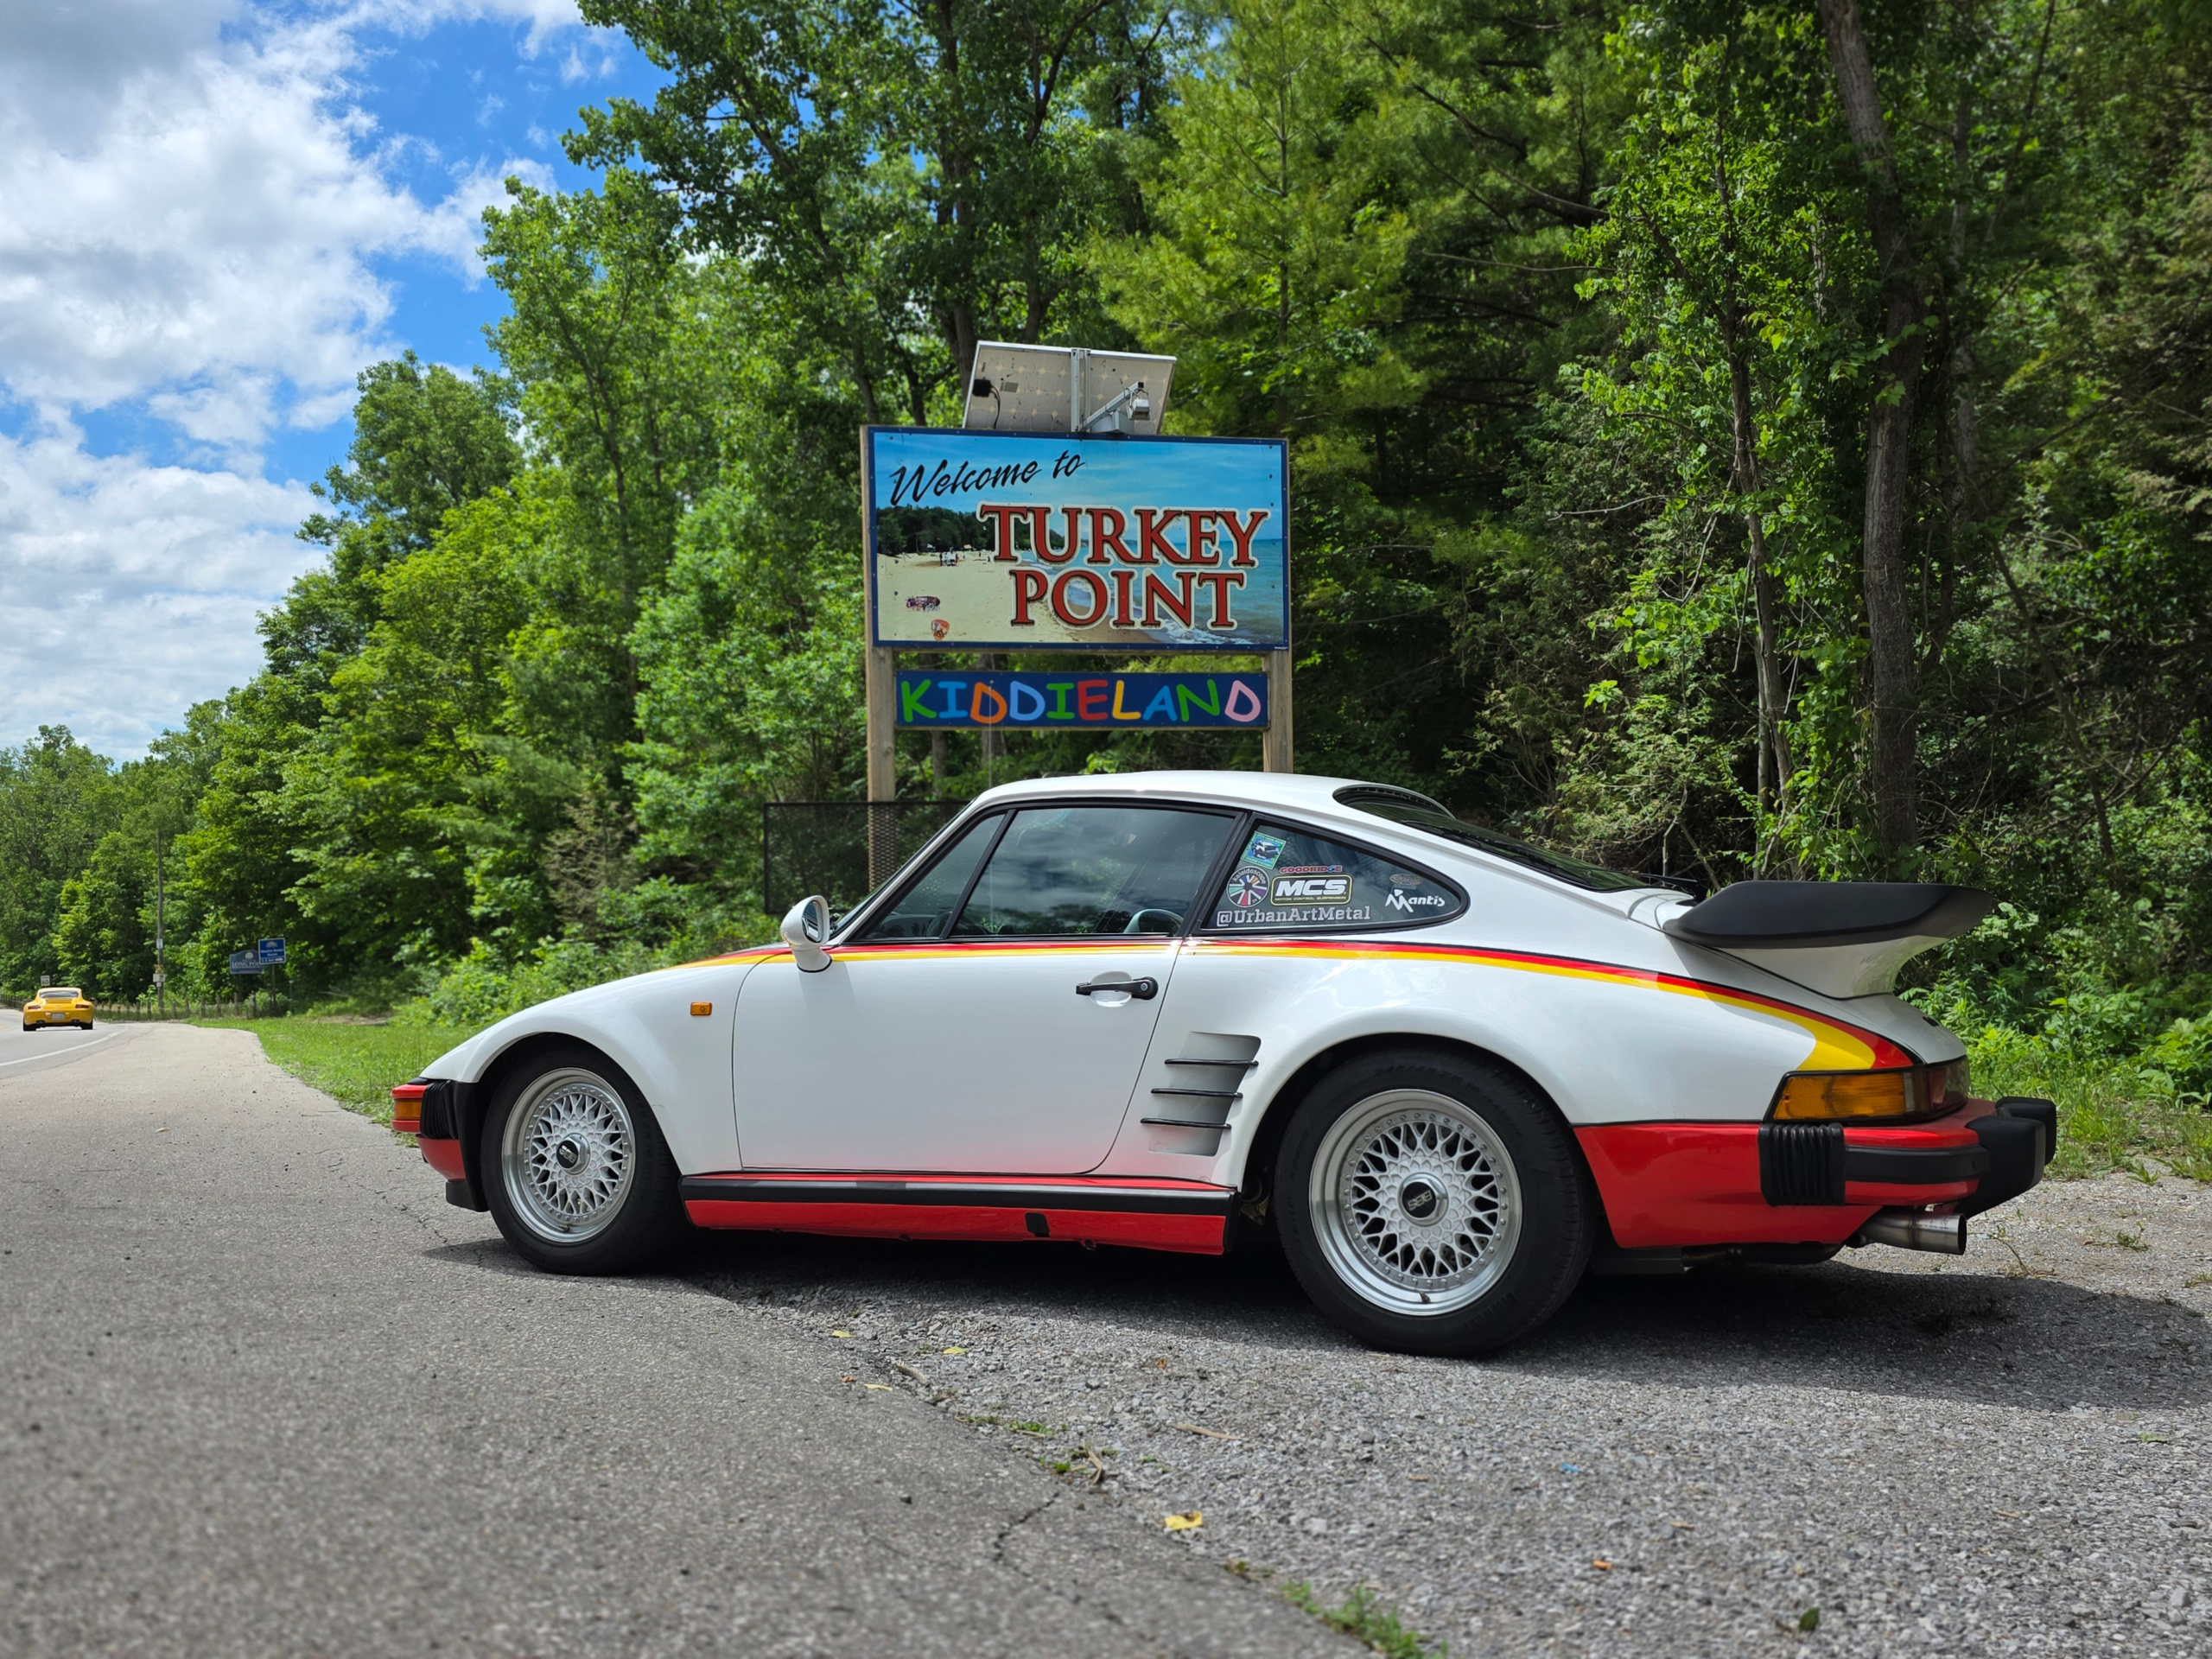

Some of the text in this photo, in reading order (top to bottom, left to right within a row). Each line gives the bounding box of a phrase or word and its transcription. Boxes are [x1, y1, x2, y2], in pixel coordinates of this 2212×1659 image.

[889, 450, 1085, 505] Welcome to
[978, 504, 1269, 568] TURKEY
[1008, 569, 1246, 628] POINT
[900, 679, 1262, 722] KIDDIELAND
[1280, 865, 1343, 874] GOODRIDGE
[1275, 879, 1347, 897] MCS
[1385, 889, 1446, 912] Mantis
[1217, 906, 1370, 927] @UrbanArtMetal
[1408, 1190, 1433, 1211] BBS
